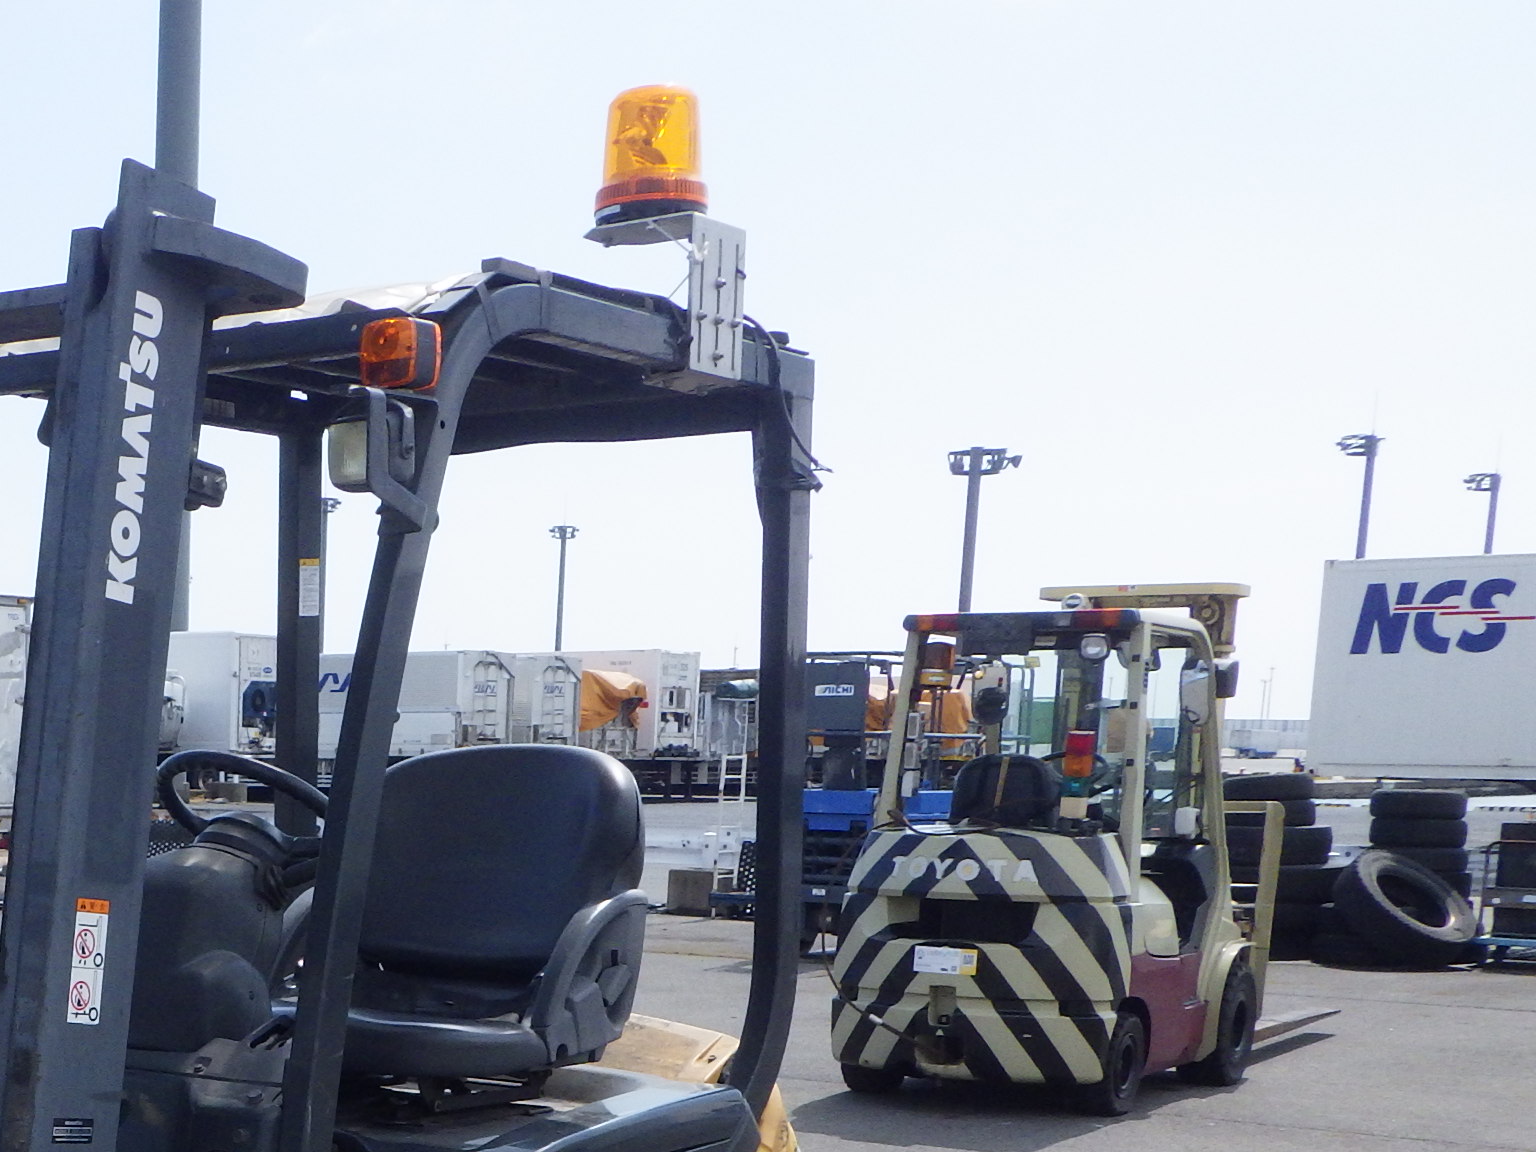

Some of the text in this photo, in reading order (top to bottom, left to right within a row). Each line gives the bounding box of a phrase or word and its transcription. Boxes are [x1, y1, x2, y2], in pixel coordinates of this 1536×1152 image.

[105, 290, 164, 604] KOMATSU
[1349, 578, 1517, 655] NCS
[820, 686, 852, 695] AICHI
[892, 855, 1038, 883] TOYOTA
